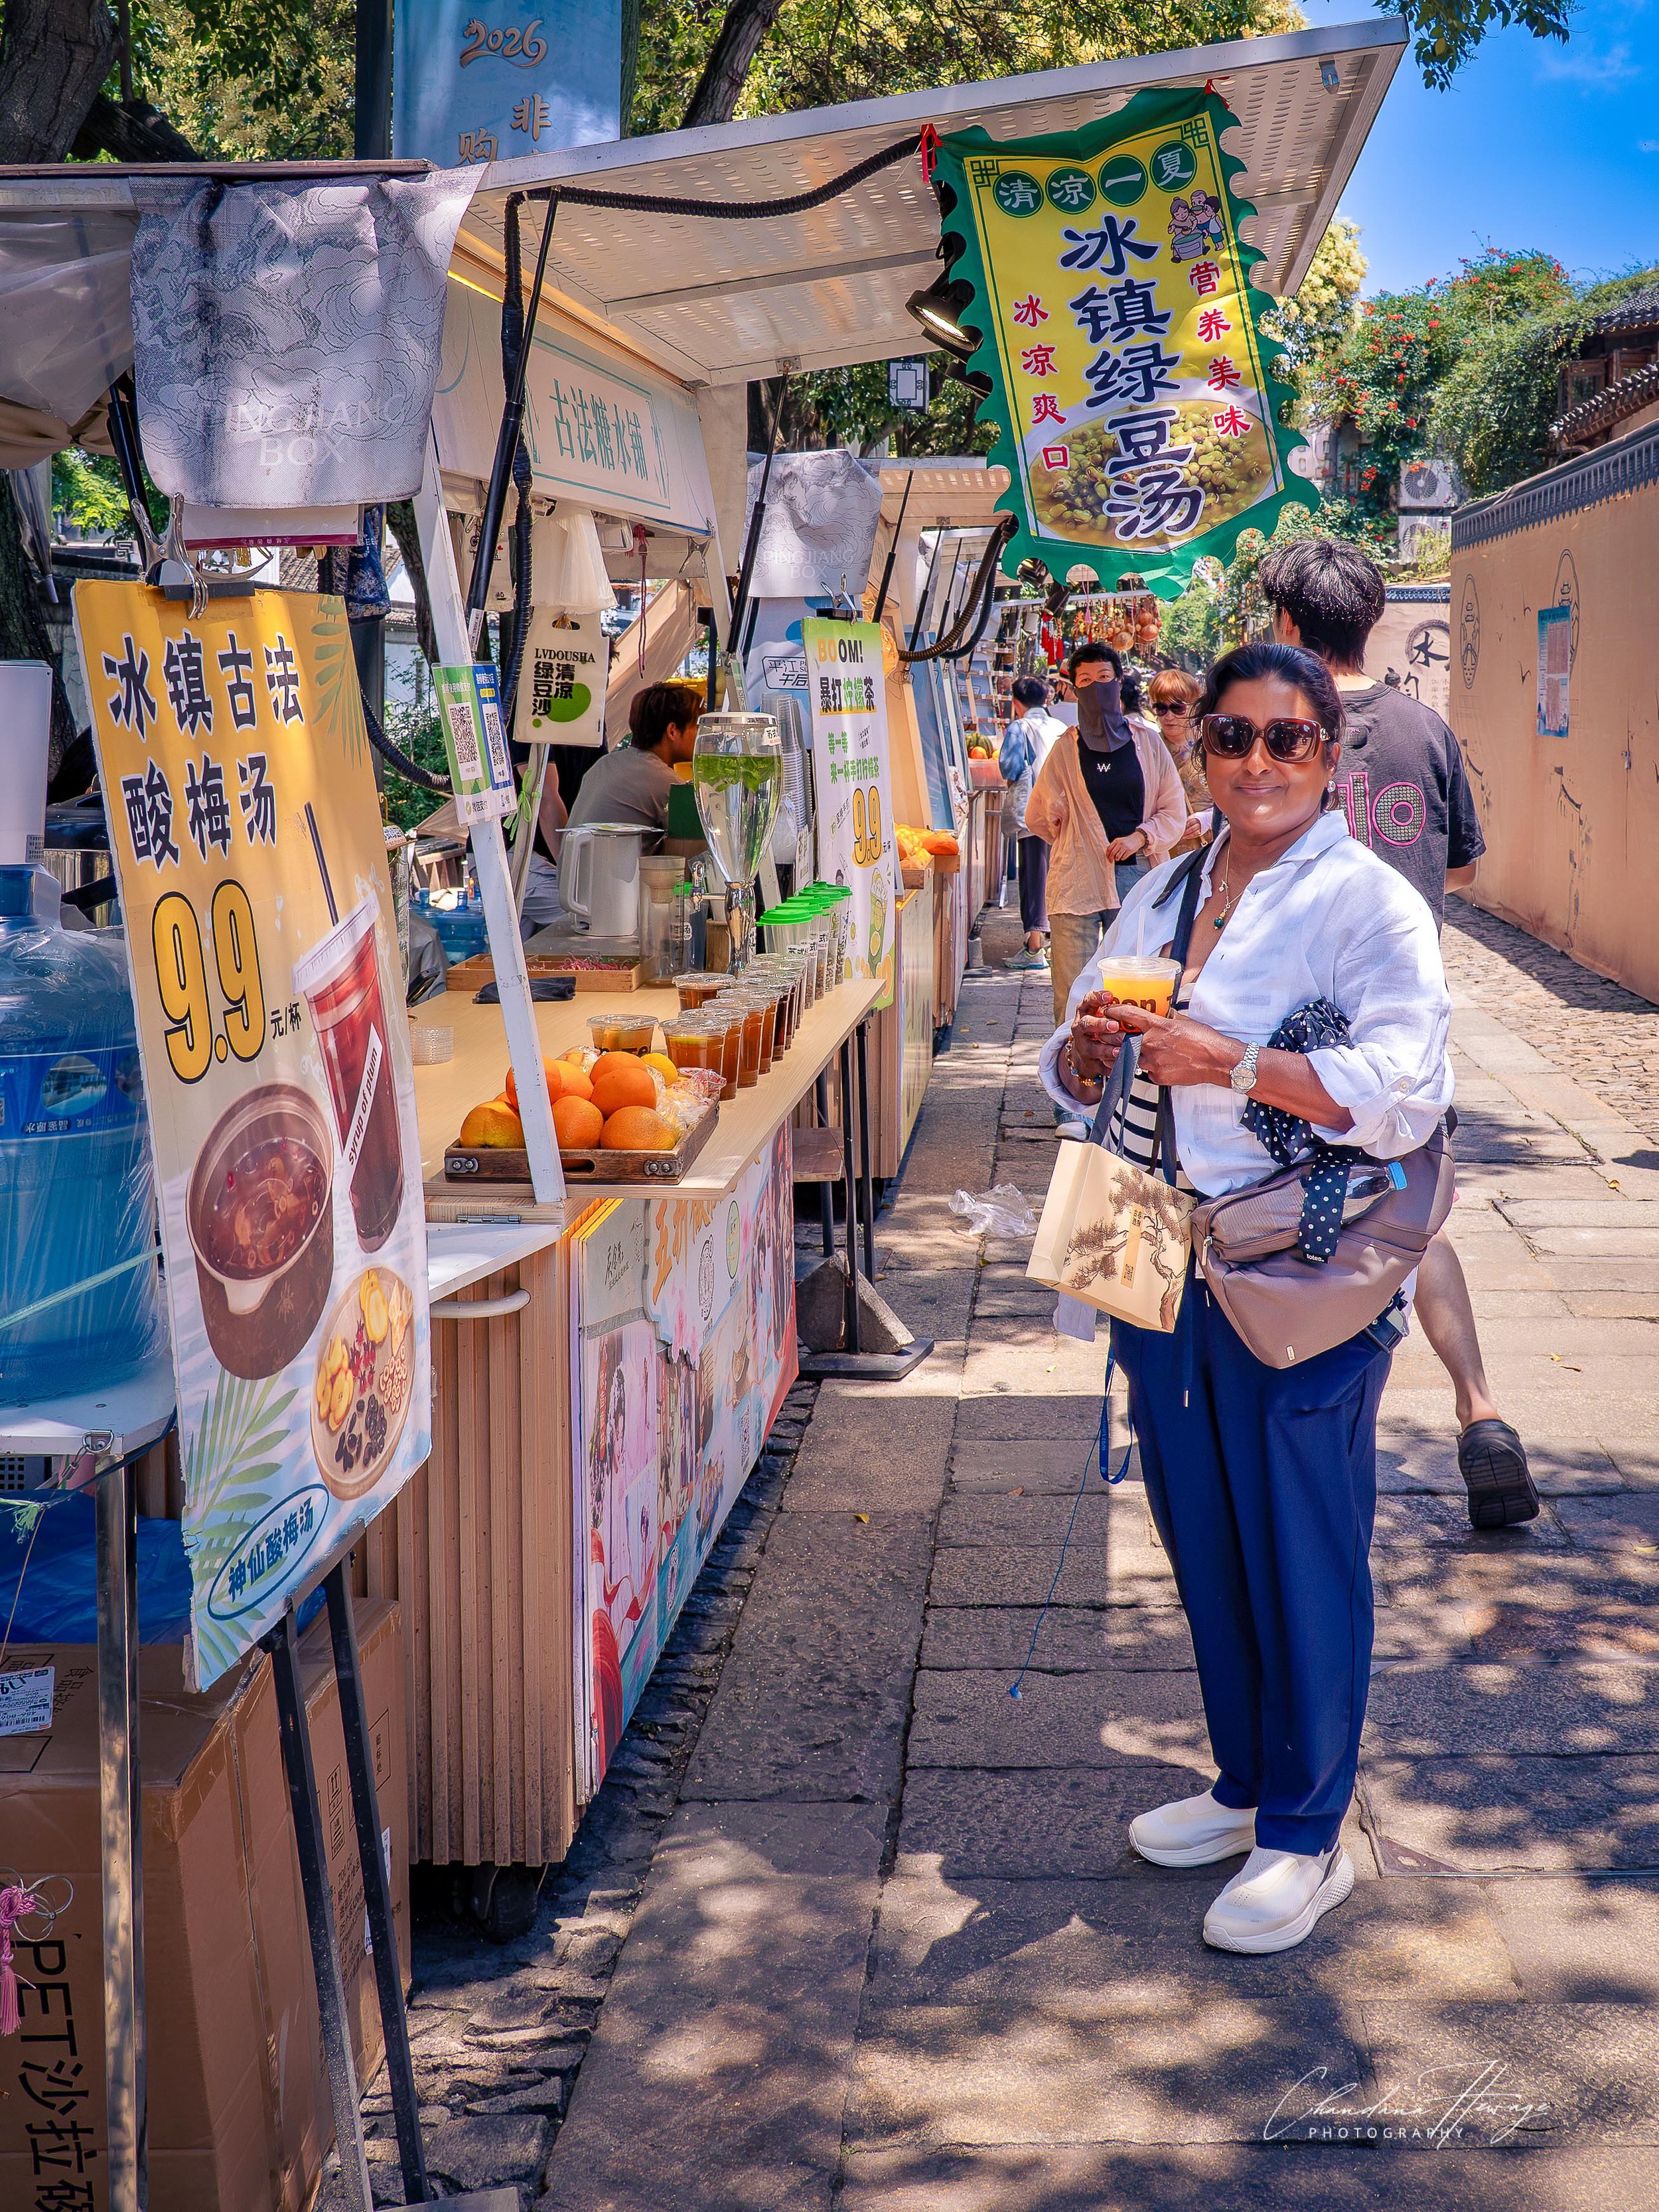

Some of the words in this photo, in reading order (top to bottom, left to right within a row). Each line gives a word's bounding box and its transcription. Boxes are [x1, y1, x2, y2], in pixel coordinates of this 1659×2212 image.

[460, 19, 547, 68] 2026
[510, 92, 552, 153] 非
[999, 145, 1193, 210] 清凉一夏
[1060, 214, 1204, 539] 冰镇绿豆汤
[1189, 261, 1252, 439] 营养美味
[1013, 295, 1068, 470] 冰凉爽口
[259, 436, 346, 466] BOX
[549, 378, 648, 481] 古法糖水铺
[790, 565, 828, 579] BOX
[535, 648, 596, 663] LVDOUSHA
[554, 662, 576, 699] 清凉
[768, 659, 798, 673] 平江
[778, 673, 808, 687] 午后
[817, 638, 864, 663] BOOM!
[102, 630, 304, 739] 冰镇古法
[532, 661, 554, 716] 绿豆沙
[820, 676, 875, 713] 暴打柠檬茶
[121, 752, 276, 872] 酸梅汤
[852, 785, 882, 864] 9.9
[151, 878, 266, 1085] 9.9
[270, 1002, 302, 1040] 元/杯
[348, 1119, 364, 1165] syrup
[366, 1047, 378, 1097] plum
[228, 1496, 314, 1603] 神仙酸梅汤
